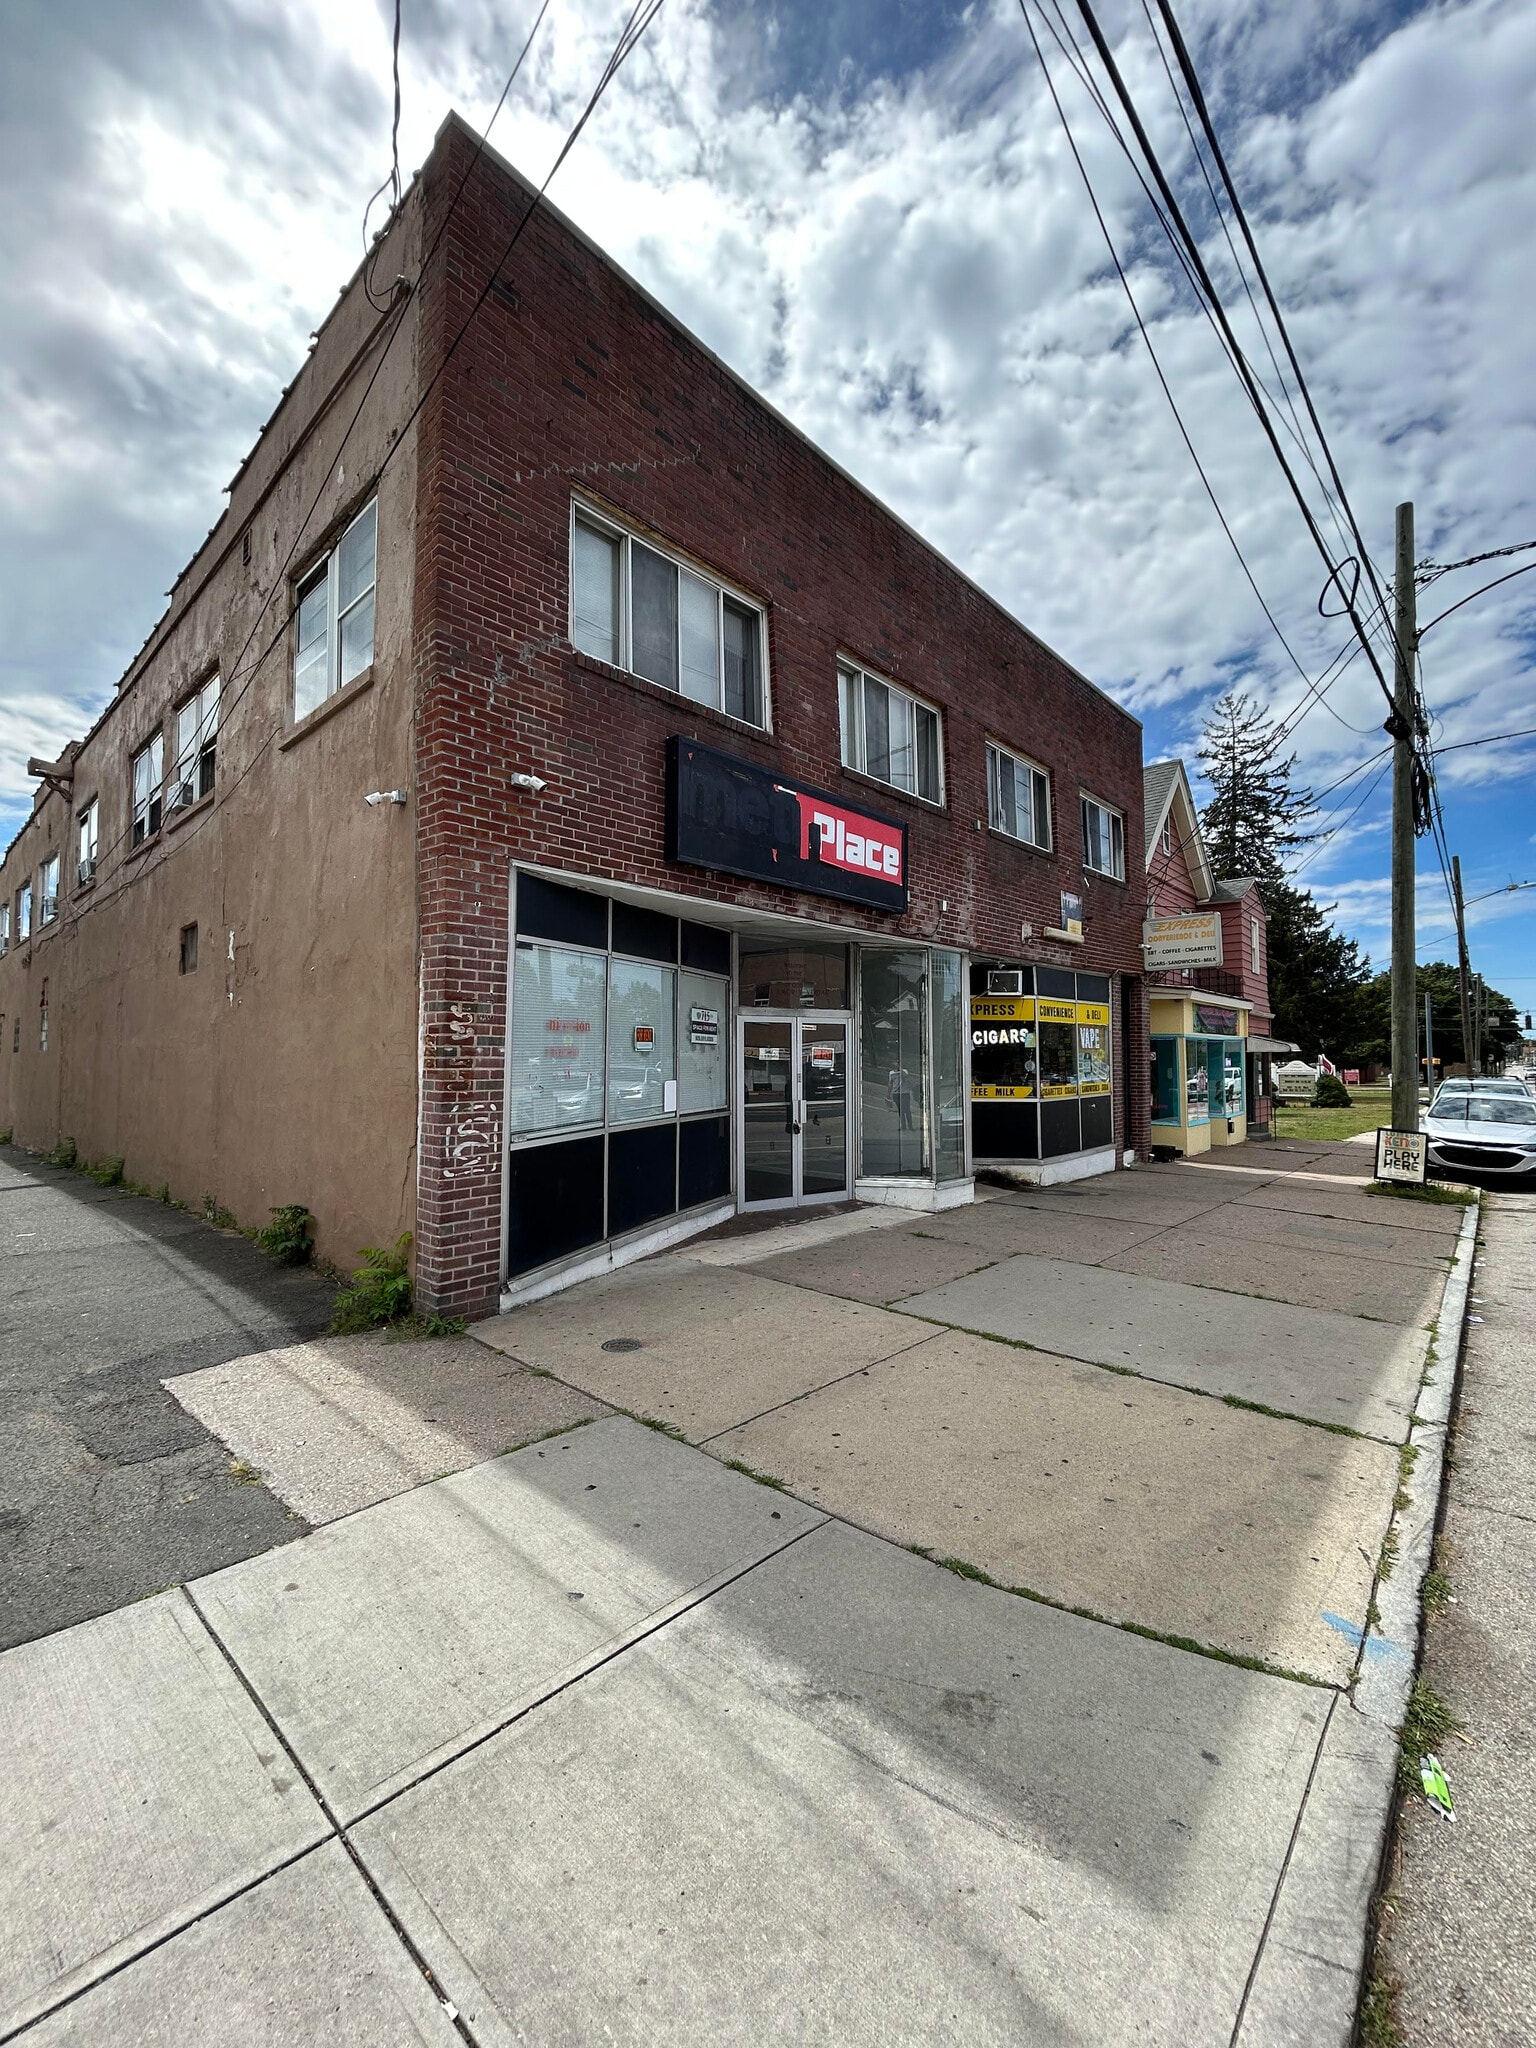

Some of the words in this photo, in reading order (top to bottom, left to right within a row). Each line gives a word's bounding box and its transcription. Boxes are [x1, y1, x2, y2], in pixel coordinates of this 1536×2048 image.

[814, 811, 900, 877] Place
[1156, 917, 1215, 932] EXPRESS
[1040, 1005, 1074, 1019] CONVENIENCE
[1092, 1010, 1101, 1020] DELI
[973, 1028, 1029, 1045] CIGARS
[1080, 1028, 1100, 1049] VAPE
[996, 1087, 1015, 1097] MILK
[1384, 1149, 1420, 1161] PLAY
[1383, 1159, 1420, 1171] HERE
